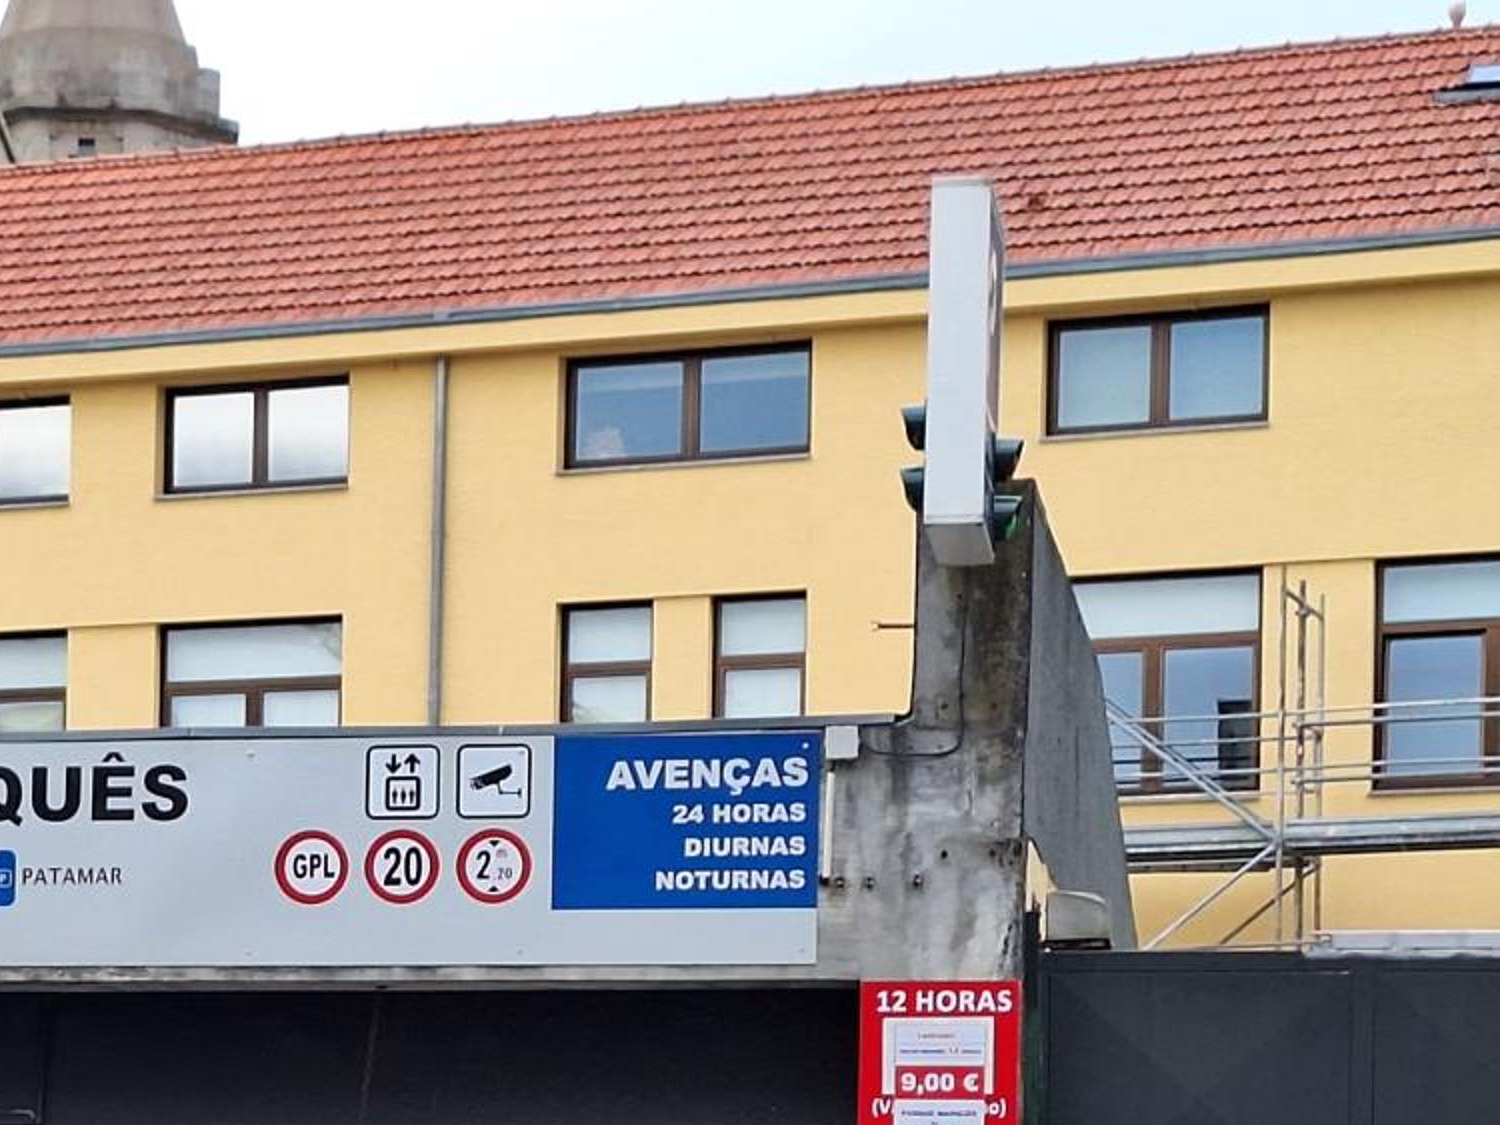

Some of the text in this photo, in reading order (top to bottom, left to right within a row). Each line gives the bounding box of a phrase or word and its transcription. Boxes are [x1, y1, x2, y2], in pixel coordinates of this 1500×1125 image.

[606, 757, 809, 795] AVENÇAS
[672, 802, 806, 824] 24 HORAS
[684, 836, 806, 857] DIURNAS
[22, 867, 122, 886] PATAMAR
[293, 853, 335, 879] GPL
[383, 846, 423, 886] 20
[655, 869, 806, 891] NOTURNAS
[876, 990, 1013, 1012] 12 HORAS
[901, 1073, 979, 1095] 9,00 €
